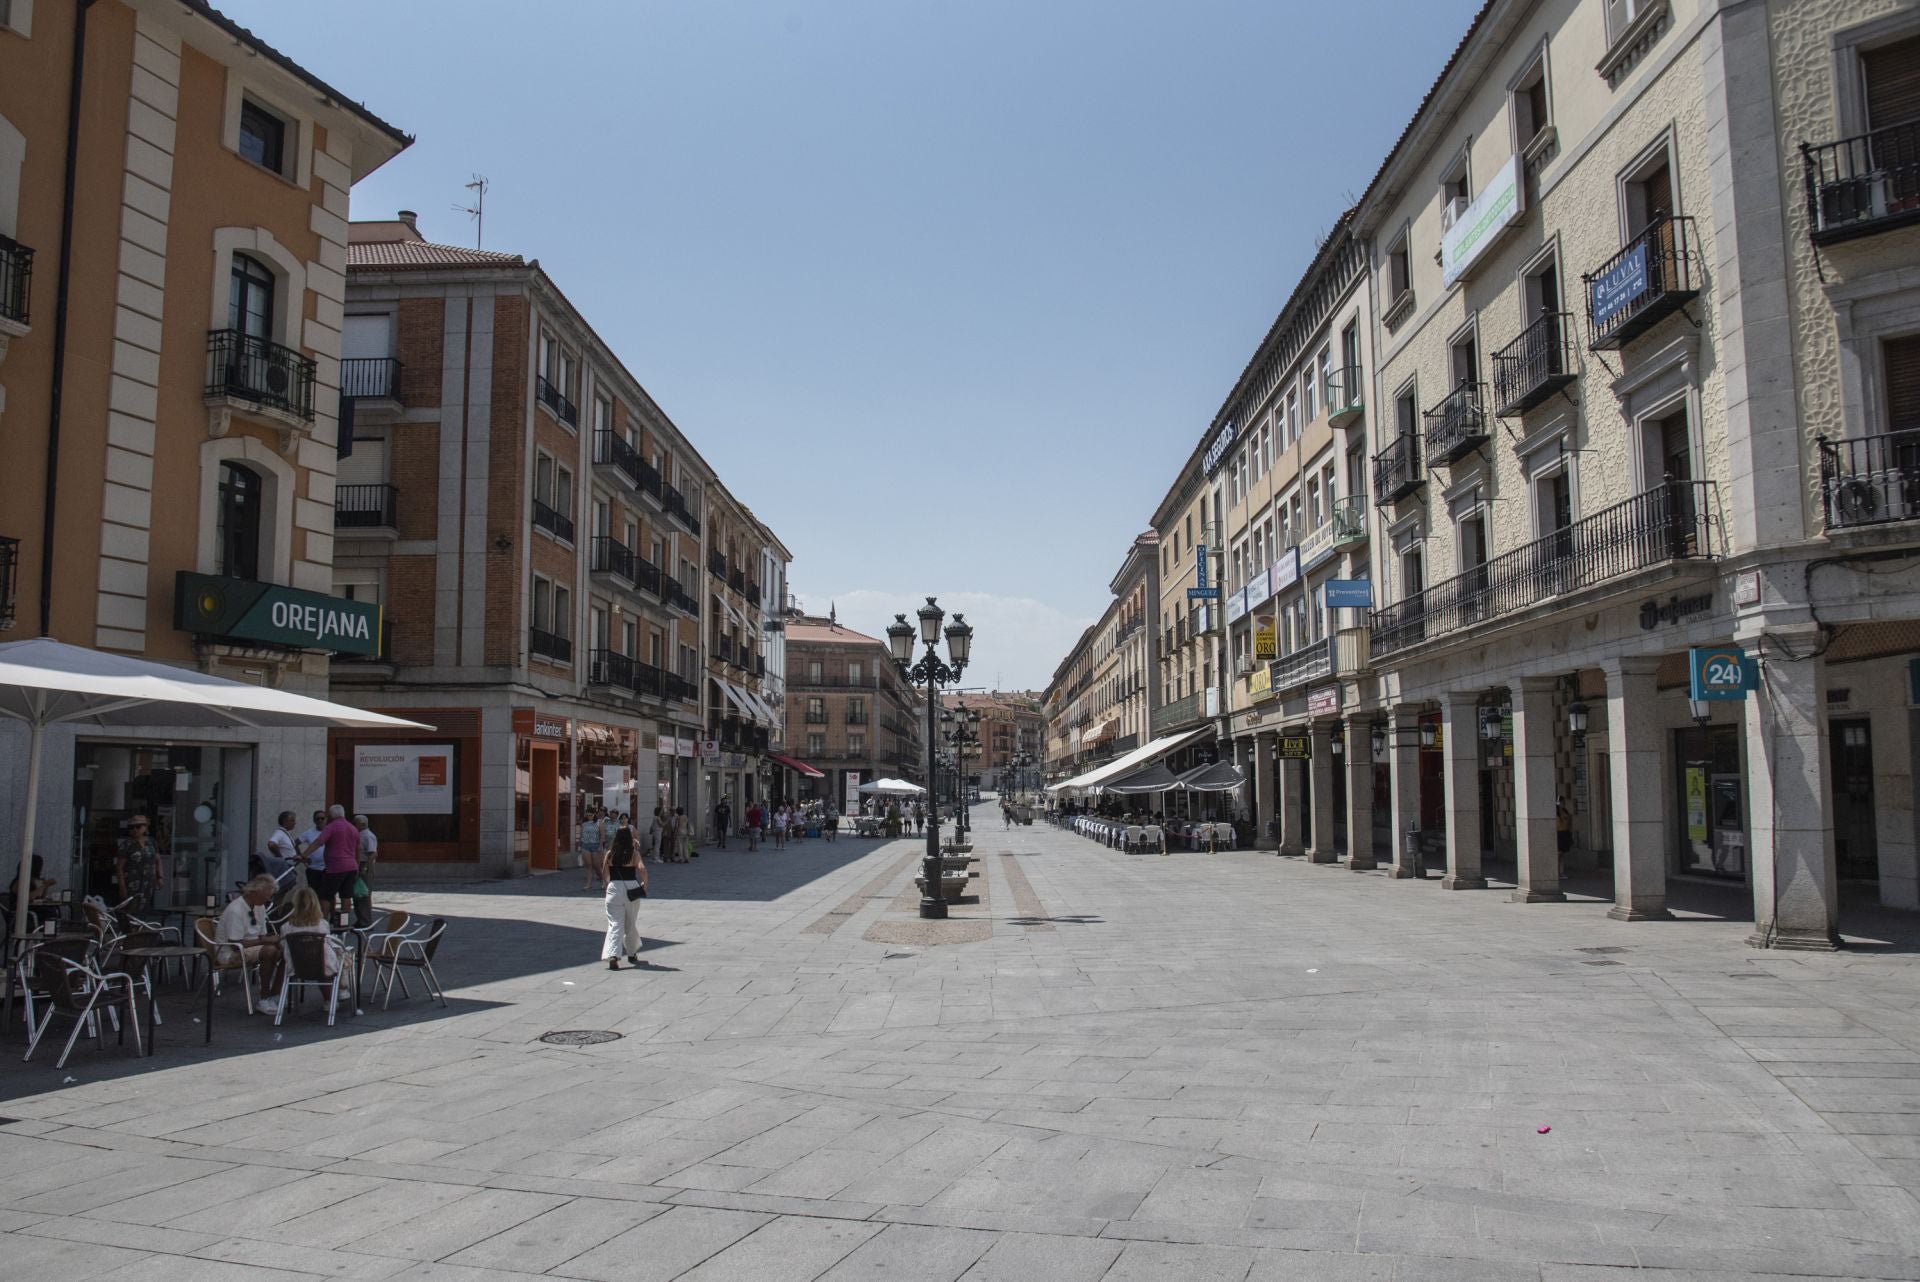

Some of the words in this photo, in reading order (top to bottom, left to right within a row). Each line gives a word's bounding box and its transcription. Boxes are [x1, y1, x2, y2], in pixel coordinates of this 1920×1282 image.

[1606, 255, 1641, 292] LUVAL
[1211, 421, 1233, 464] SEGUROS
[272, 601, 369, 641] OREJANA
[1256, 642, 1276, 653] ORO
[1254, 671, 1267, 691] ORO
